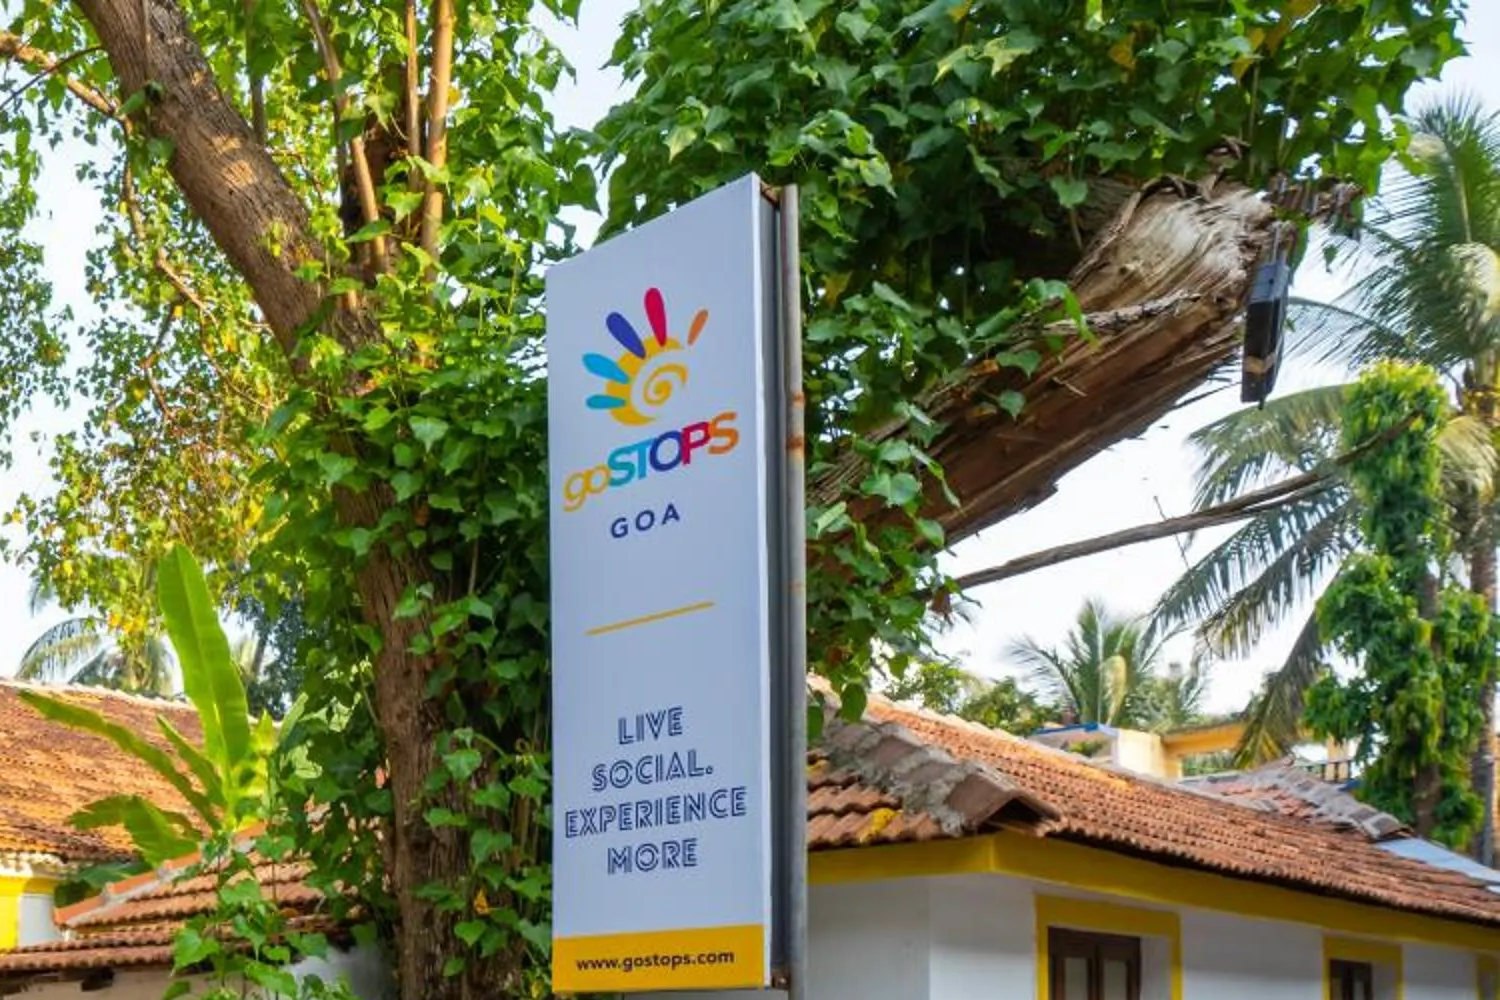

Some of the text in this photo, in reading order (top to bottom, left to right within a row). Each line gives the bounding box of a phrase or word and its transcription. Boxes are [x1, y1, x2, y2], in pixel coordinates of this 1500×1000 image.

[562, 411, 739, 512] goSTOPS
[610, 503, 680, 538] GOA
[618, 706, 683, 745] LIVE
[591, 749, 714, 792] SOCIAL.
[565, 786, 747, 839] EXPERIENCE
[607, 838, 698, 875] MORE
[576, 951, 735, 972] www.gostops.com
